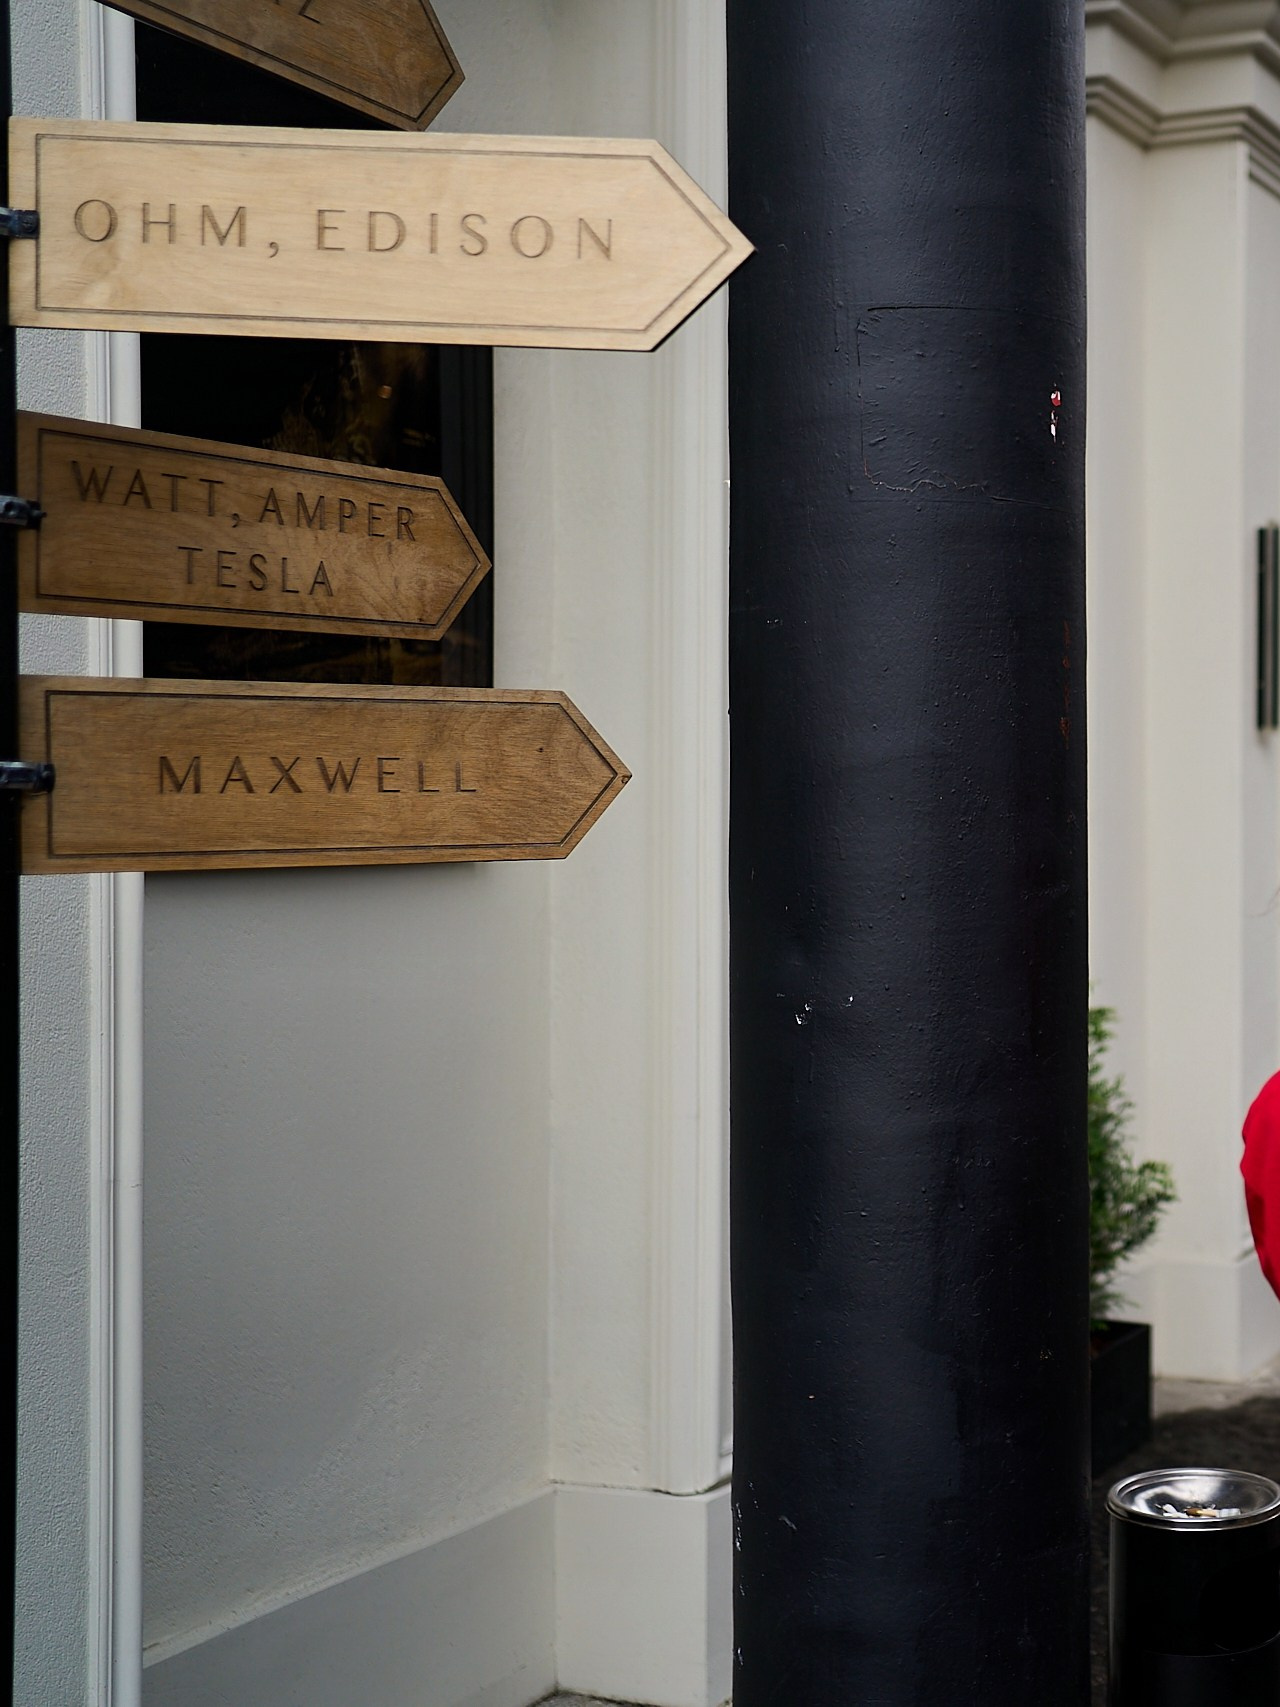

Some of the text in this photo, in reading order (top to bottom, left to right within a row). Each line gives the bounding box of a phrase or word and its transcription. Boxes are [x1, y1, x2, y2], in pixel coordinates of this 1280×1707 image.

[74, 199, 615, 261] OHM, EDISON
[70, 460, 417, 542] WATT, AMPER
[177, 545, 334, 598] TESLA
[157, 755, 478, 795] MAXWELL
